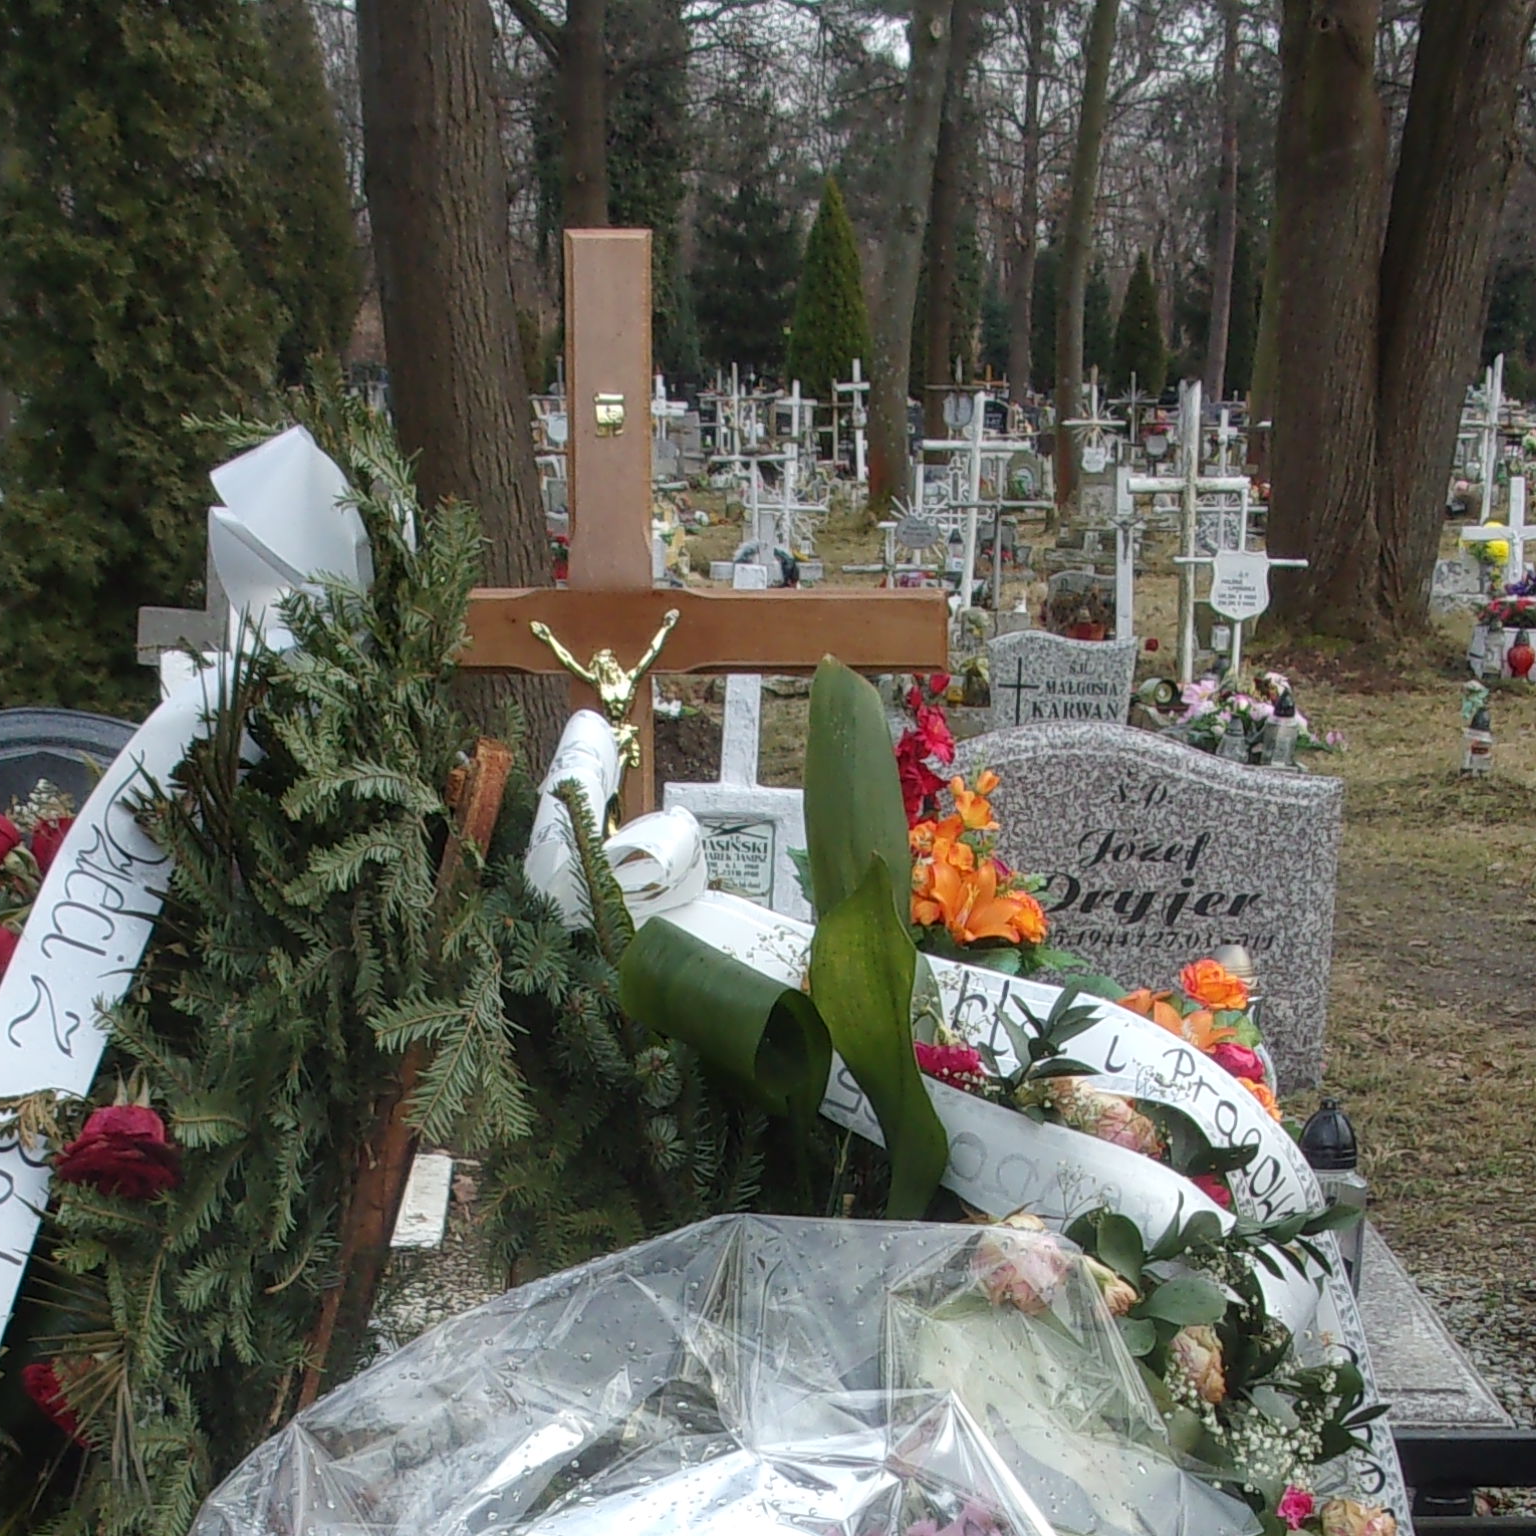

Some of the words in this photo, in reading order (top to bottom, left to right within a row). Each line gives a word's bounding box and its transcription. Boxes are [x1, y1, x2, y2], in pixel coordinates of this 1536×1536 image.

[1032, 701, 1119, 720] KARWAN
[1077, 828, 1211, 871] Józef
[1044, 869, 1263, 927] Dryjer
